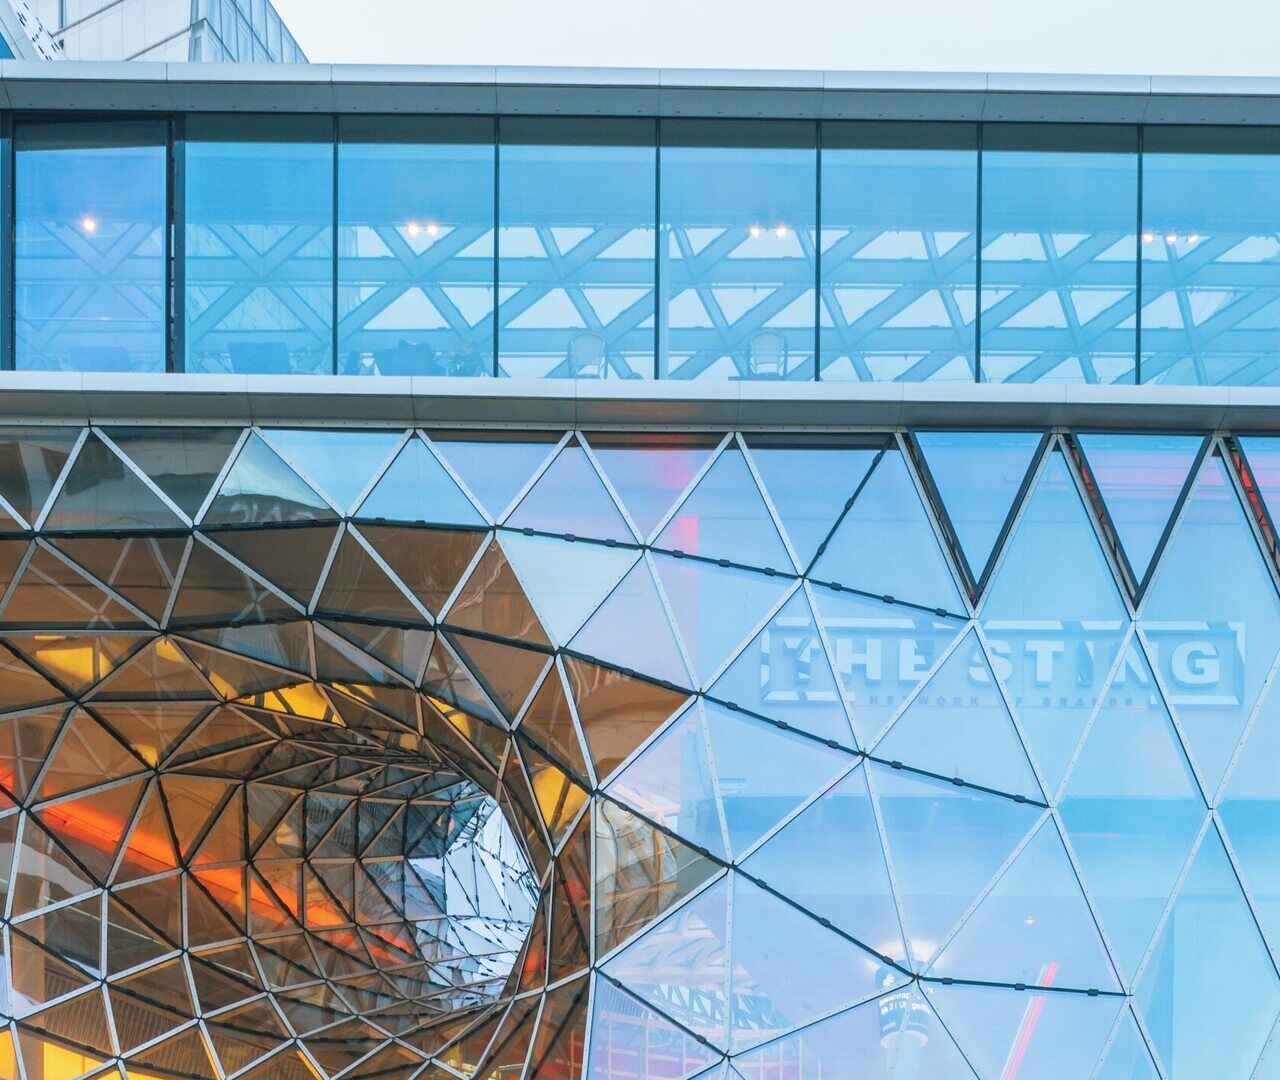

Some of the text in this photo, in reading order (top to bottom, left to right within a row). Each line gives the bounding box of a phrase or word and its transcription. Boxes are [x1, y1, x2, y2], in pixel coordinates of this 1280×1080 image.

[782, 637, 1221, 688] THE STING
[869, 696, 981, 708] NEWORK
